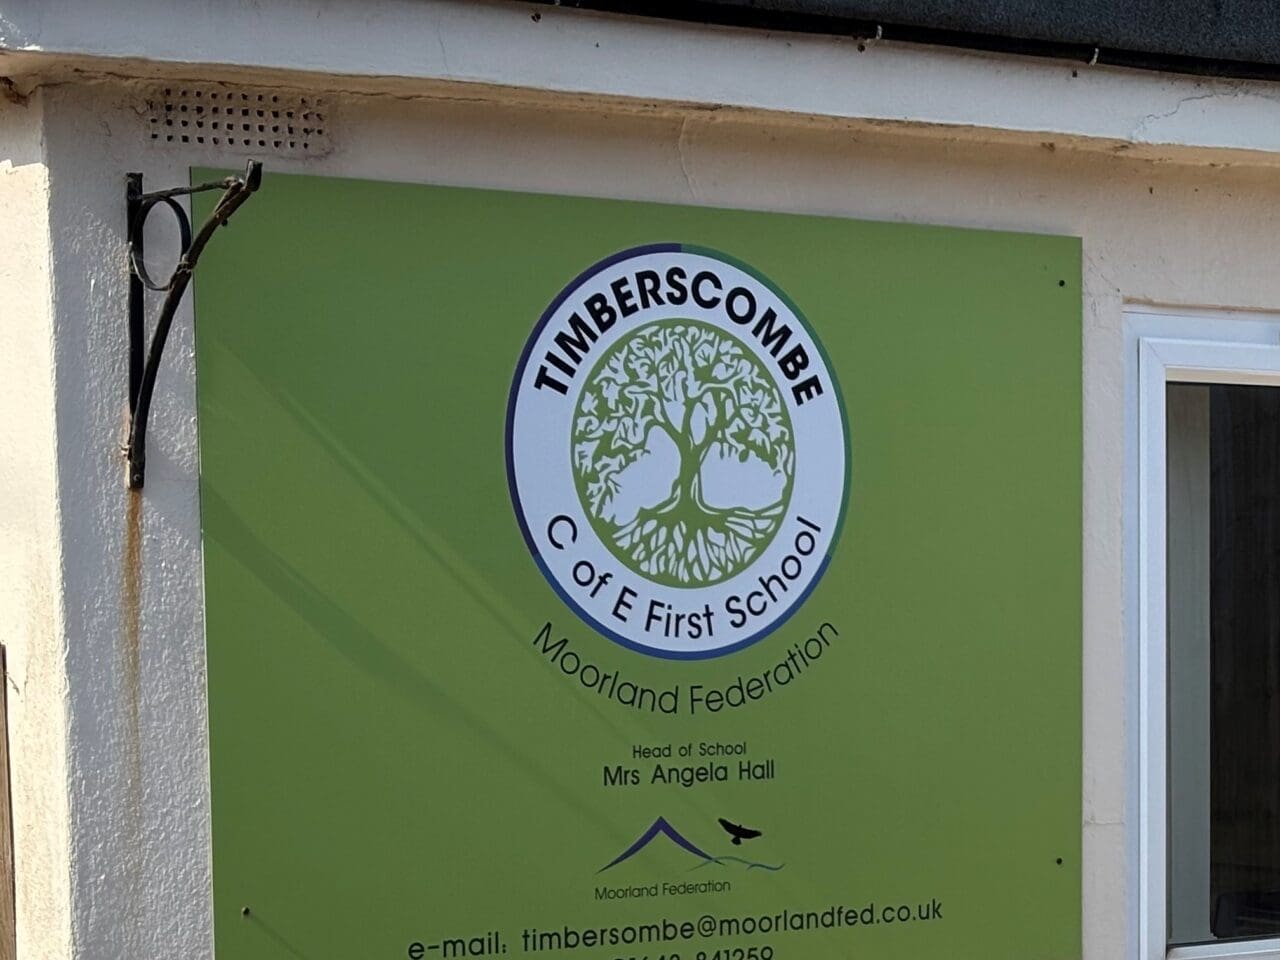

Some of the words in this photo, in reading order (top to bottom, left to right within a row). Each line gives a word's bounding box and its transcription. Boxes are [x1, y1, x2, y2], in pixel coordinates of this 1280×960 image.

[533, 266, 824, 407] TIMBERSCOMBE
[547, 514, 578, 551] C
[572, 559, 613, 599] of
[612, 584, 639, 623] E
[644, 599, 716, 640] First
[724, 515, 822, 629] School
[532, 621, 679, 715] Moorland
[690, 621, 839, 715] Federation
[603, 765, 641, 787] Mrs
[650, 761, 729, 788] Angela
[738, 758, 775, 782] Hall
[632, 743, 672, 758] Head
[678, 743, 693, 758] of
[698, 741, 747, 757] School
[594, 883, 659, 900] Moorland
[662, 879, 732, 897] Federation
[521, 898, 943, 953] timbersombe@moorlandfed.co.uk
